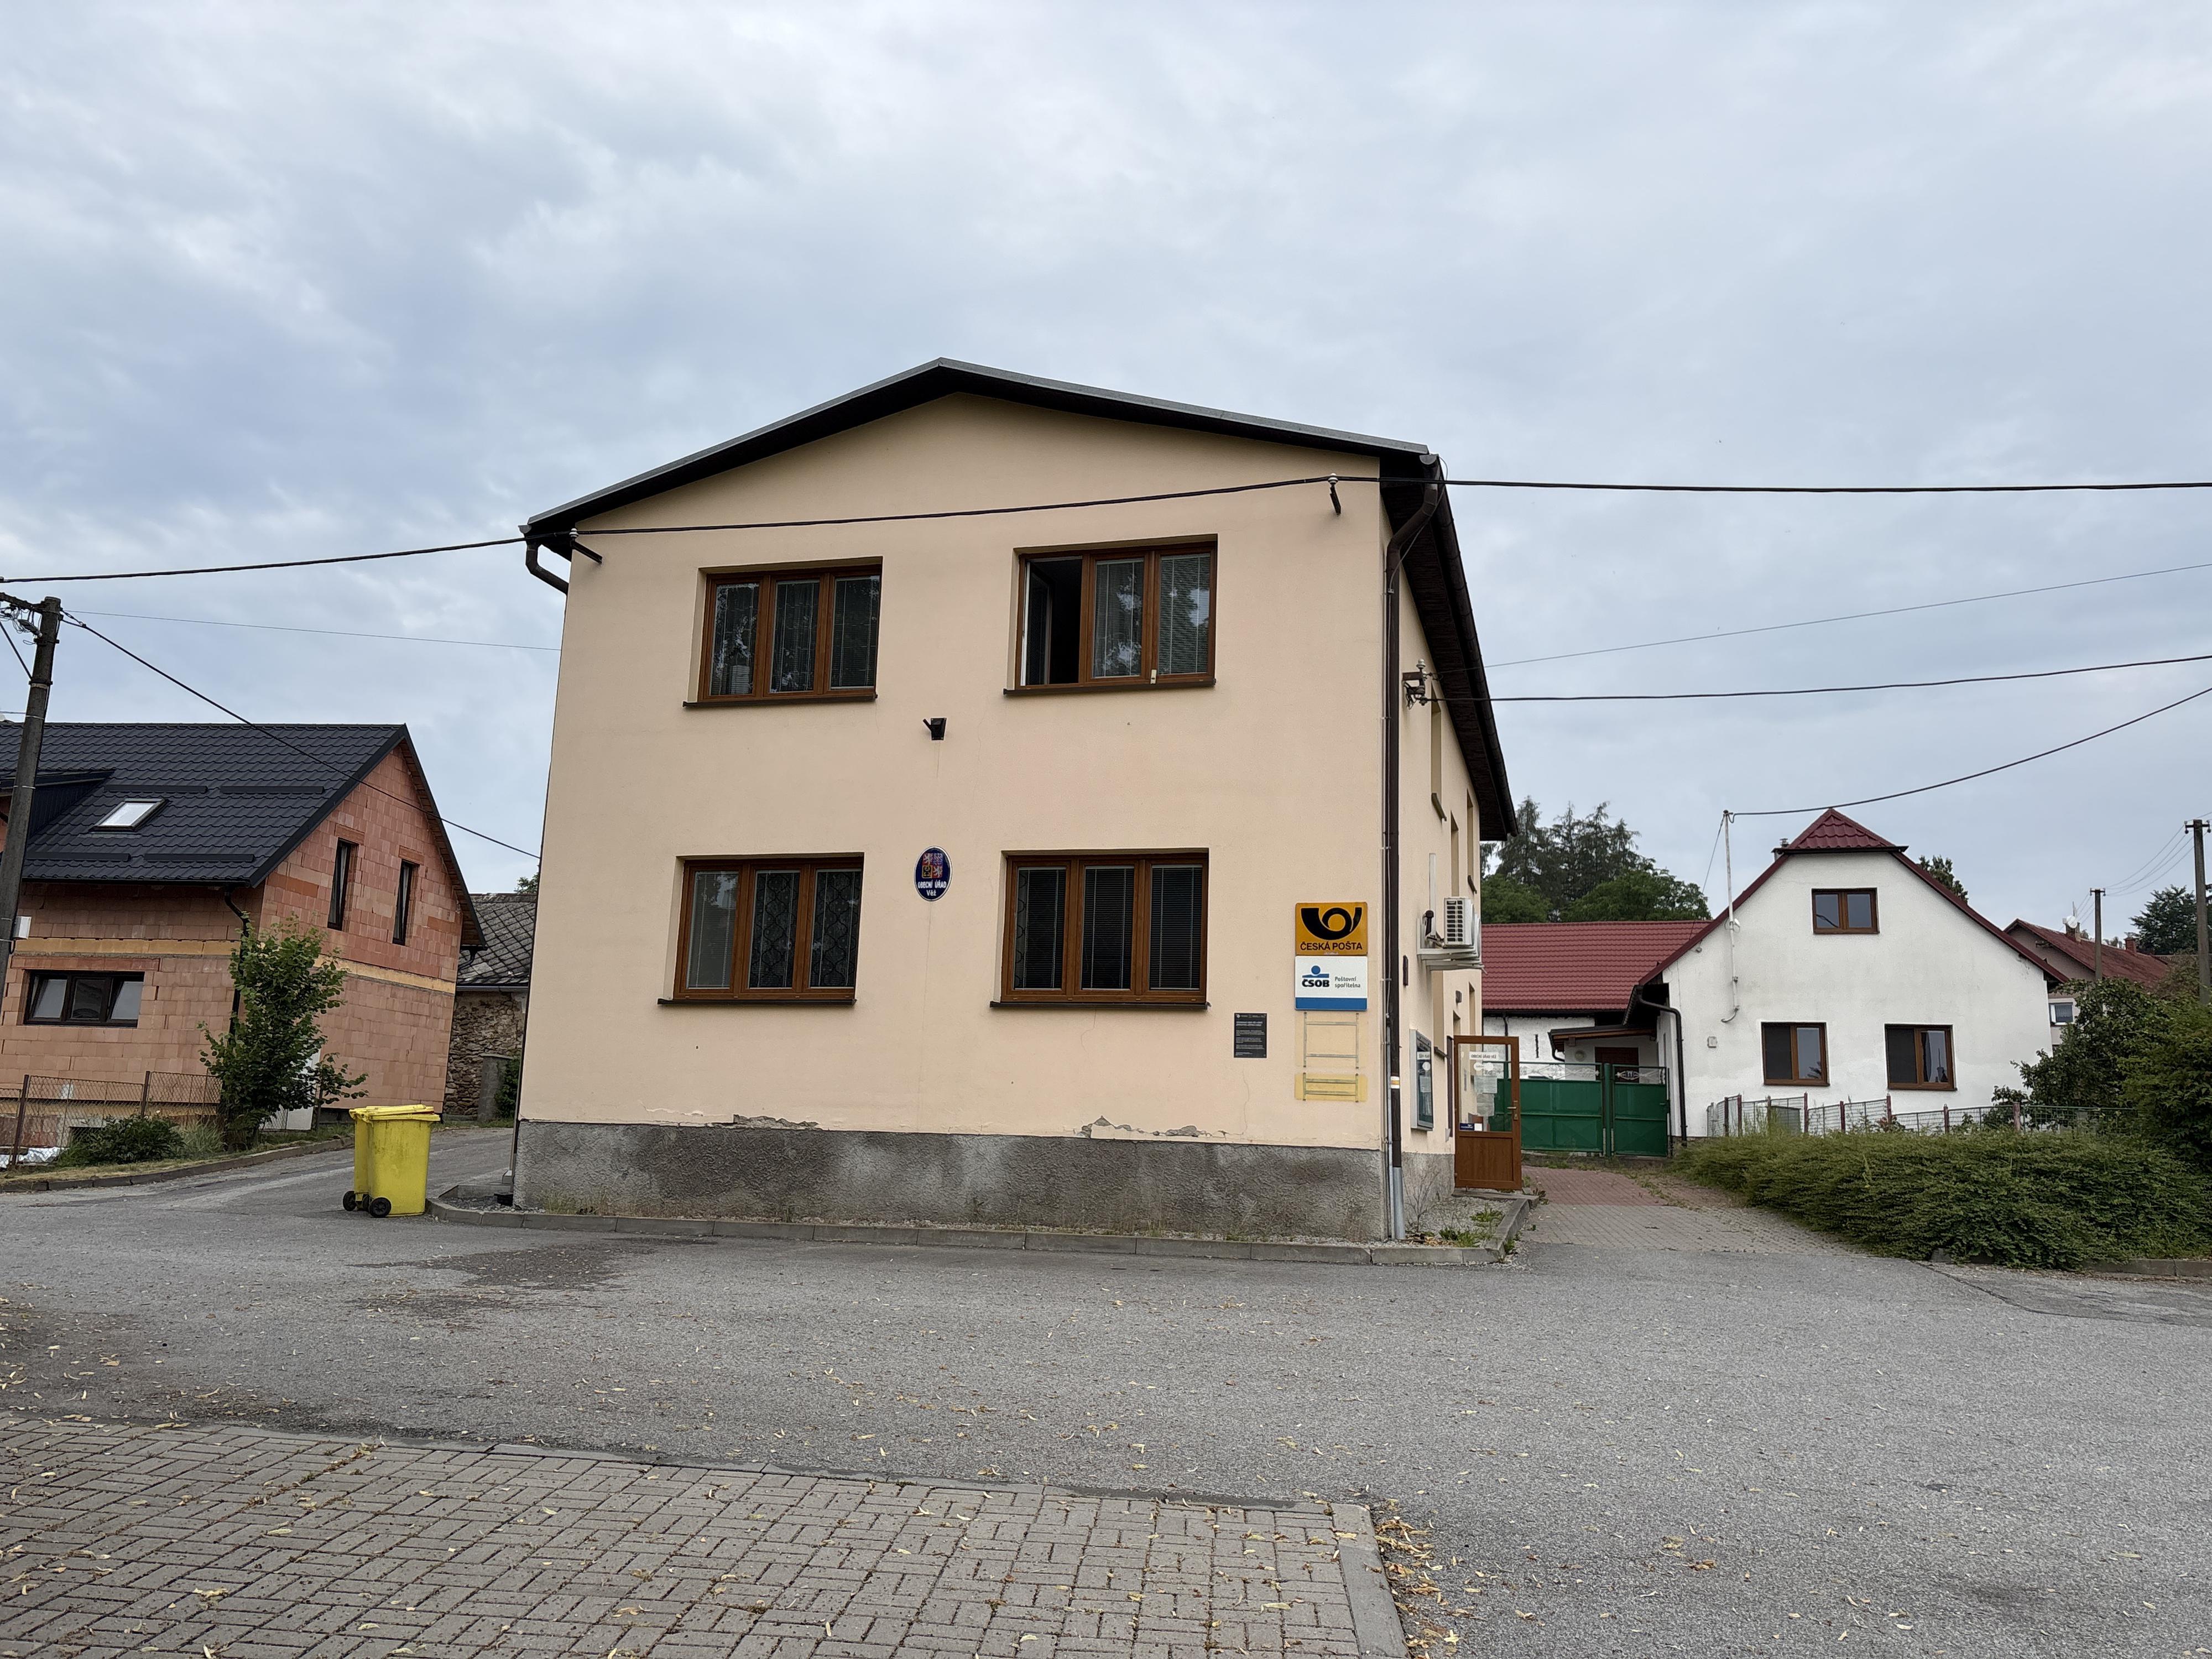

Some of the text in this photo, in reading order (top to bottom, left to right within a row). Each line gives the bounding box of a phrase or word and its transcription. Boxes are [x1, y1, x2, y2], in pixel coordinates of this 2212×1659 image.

[917, 879, 947, 888] OBECNÍ ÚŘAD
[1300, 941, 1363, 951] ČESKÁ POŠTA
[1302, 979, 1330, 987] ČSOB
